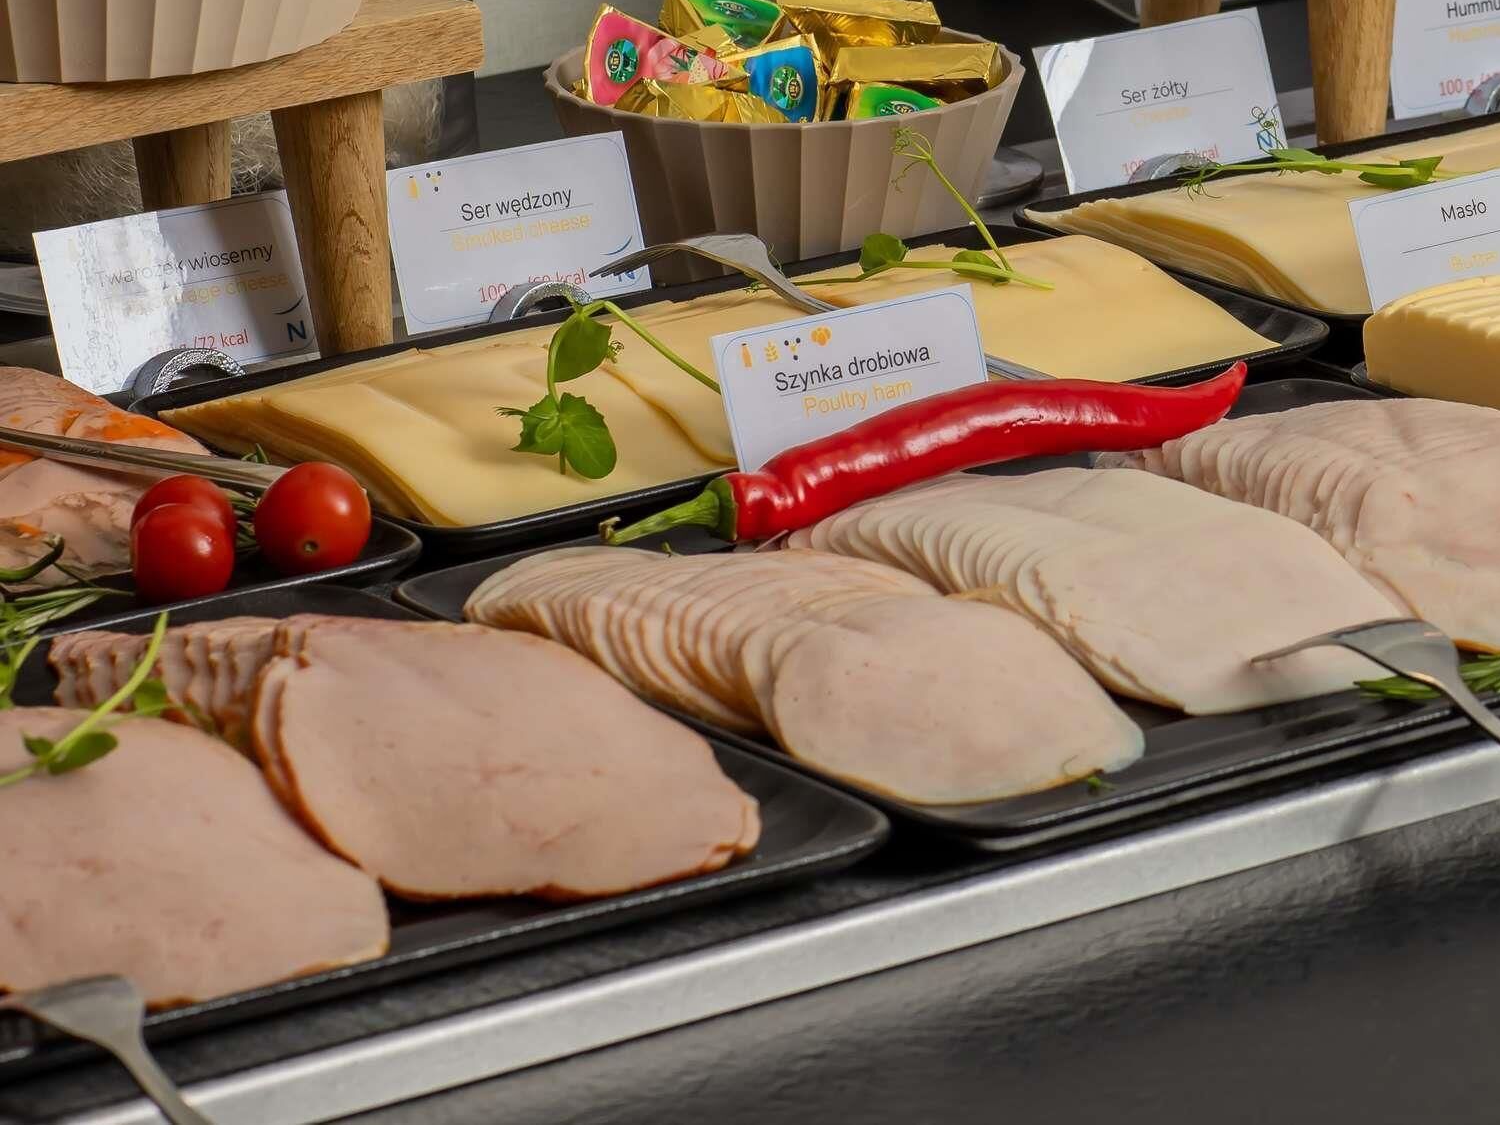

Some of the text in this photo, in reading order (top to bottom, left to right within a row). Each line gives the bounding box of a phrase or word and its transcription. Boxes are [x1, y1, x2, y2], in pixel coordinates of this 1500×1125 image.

[1121, 79, 1189, 106] Ser żółty
[1439, 78, 1463, 97] 100
[460, 186, 572, 222] Ser wędzony
[1440, 198, 1487, 222] Masło
[186, 241, 273, 273] wiosenny
[226, 273, 289, 297] cheese
[220, 328, 249, 347] kcal
[286, 320, 306, 342] N
[774, 344, 930, 393] Szynka drobiowa
[803, 379, 913, 419] Poultry ham
